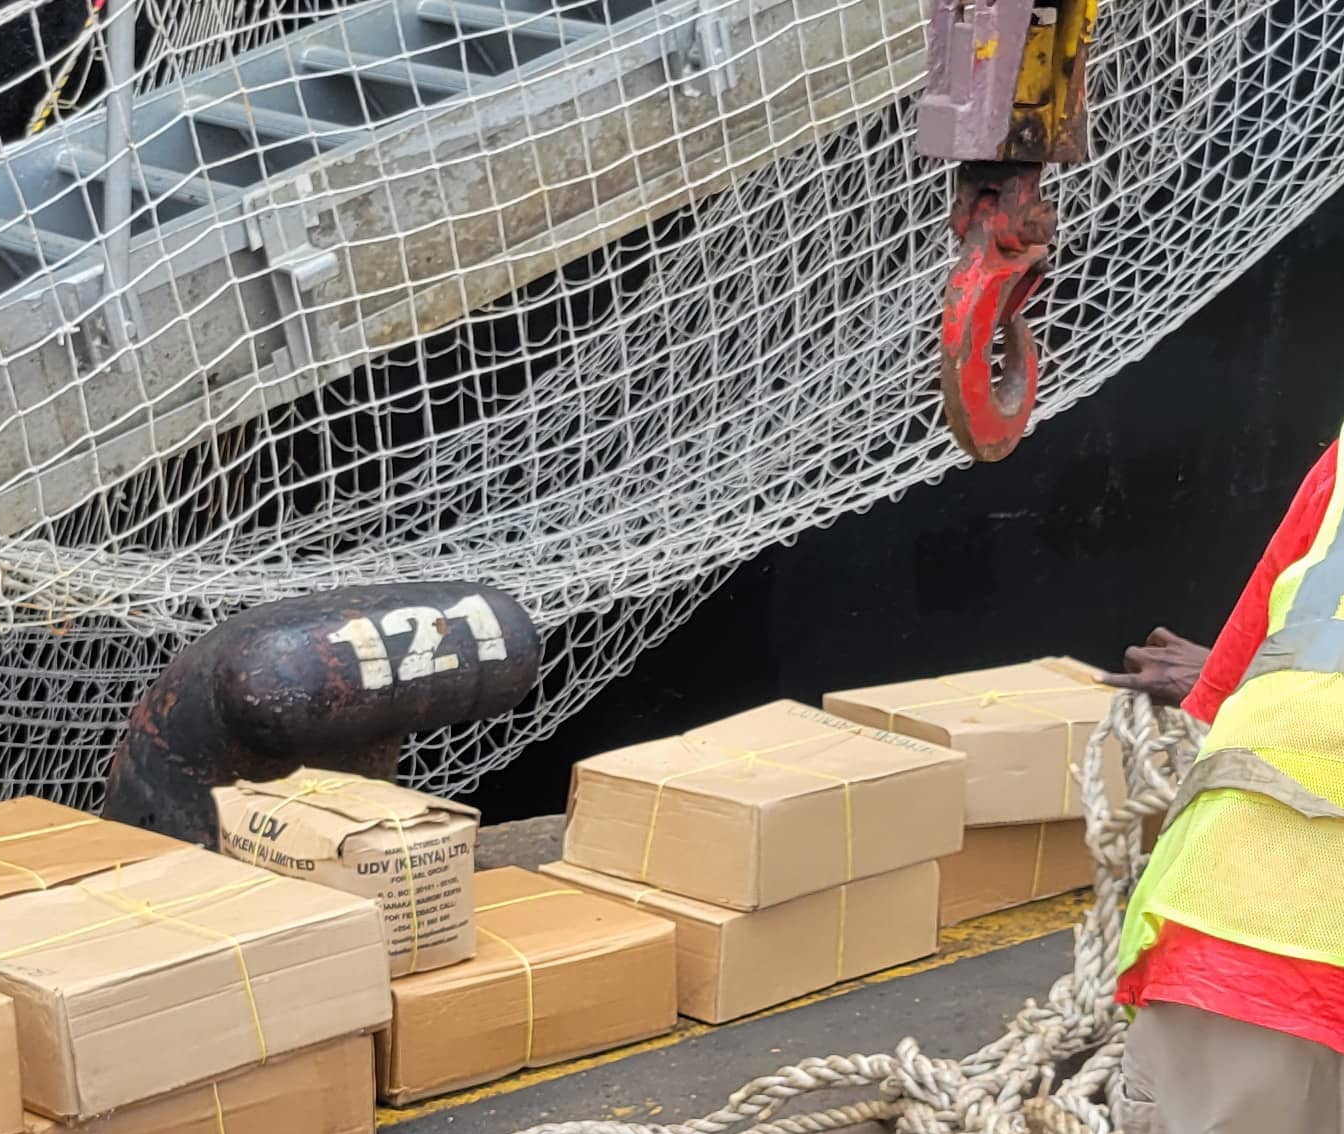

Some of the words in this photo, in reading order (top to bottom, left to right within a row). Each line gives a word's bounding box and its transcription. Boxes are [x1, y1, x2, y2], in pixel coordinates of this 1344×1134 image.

[326, 593, 508, 690] 121
[249, 811, 288, 841] UDV
[270, 849, 315, 872] LIMITED
[385, 838, 441, 856] MANUACTURED
[357, 860, 391, 875] UDV
[395, 848, 446, 874] (KENYA)
